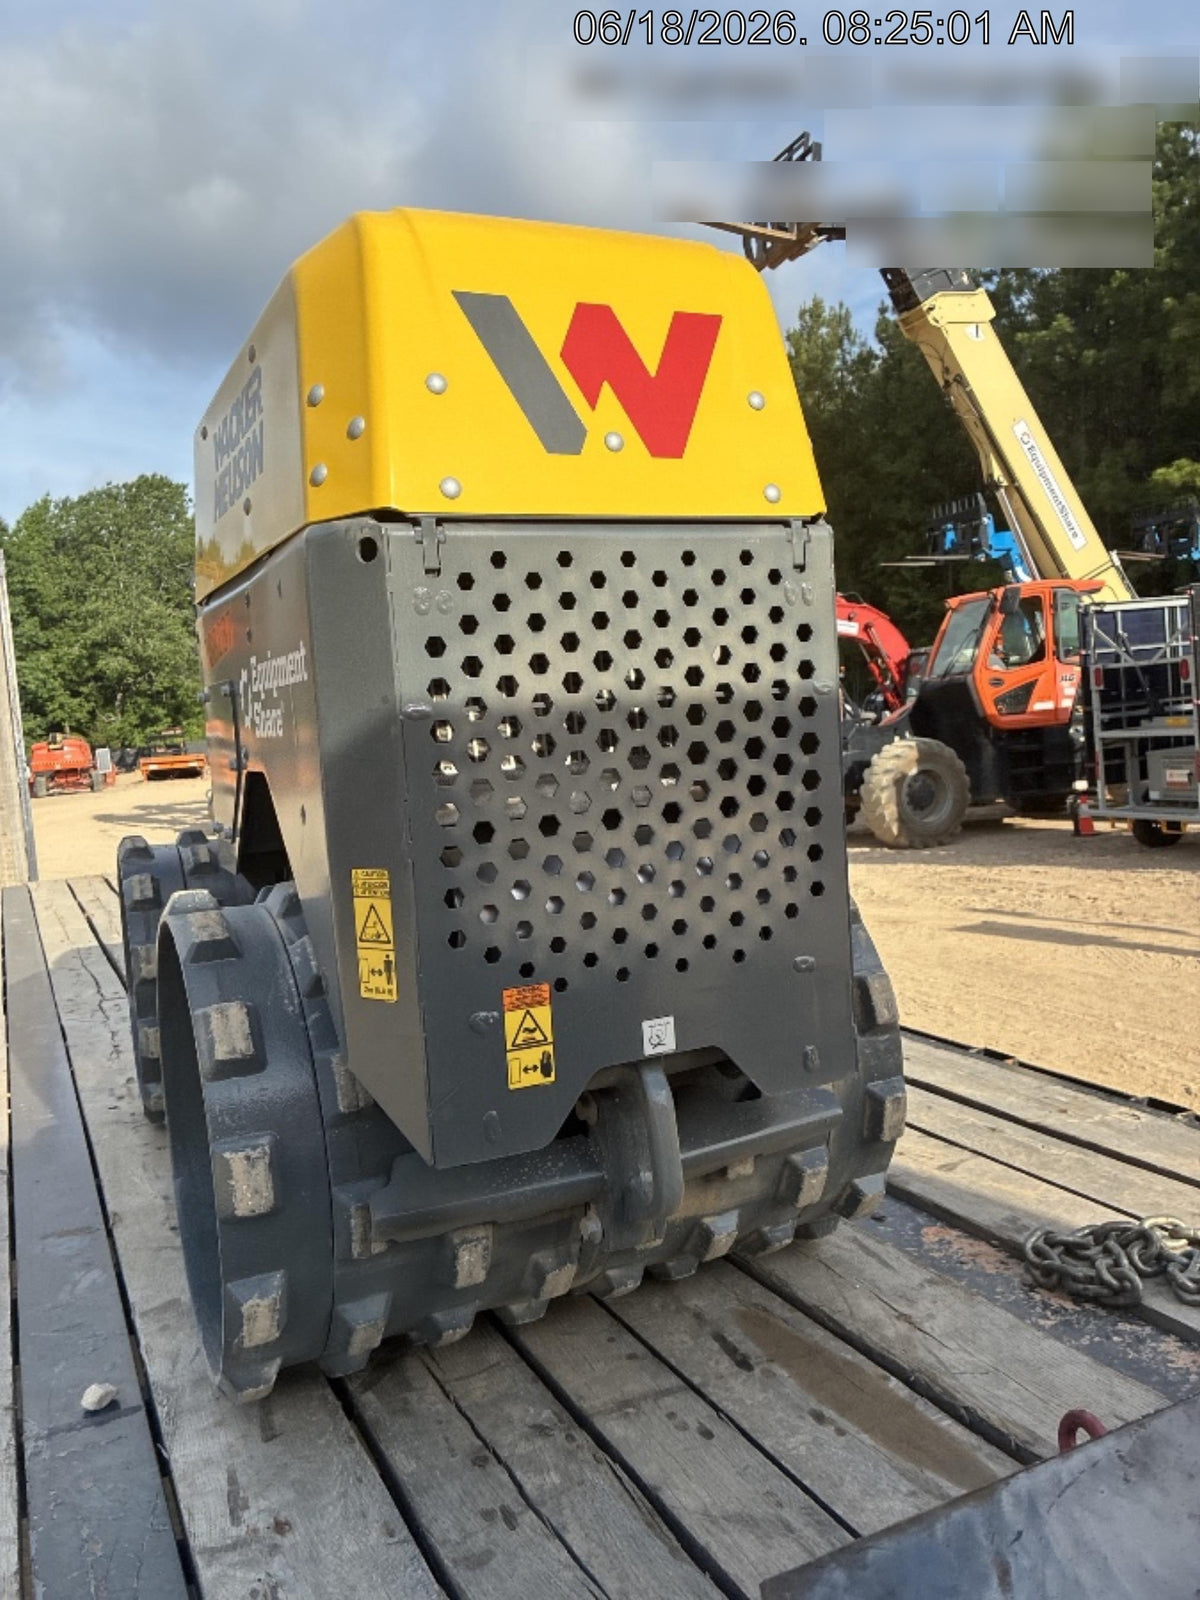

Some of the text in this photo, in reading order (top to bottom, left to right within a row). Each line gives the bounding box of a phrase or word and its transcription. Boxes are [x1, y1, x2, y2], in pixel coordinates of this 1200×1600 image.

[213, 365, 263, 473] WACKER
[214, 419, 264, 524] NEUSON
[1026, 443, 1079, 540] EquipmentShare
[249, 639, 308, 700] Equipment
[254, 701, 284, 738] Share
